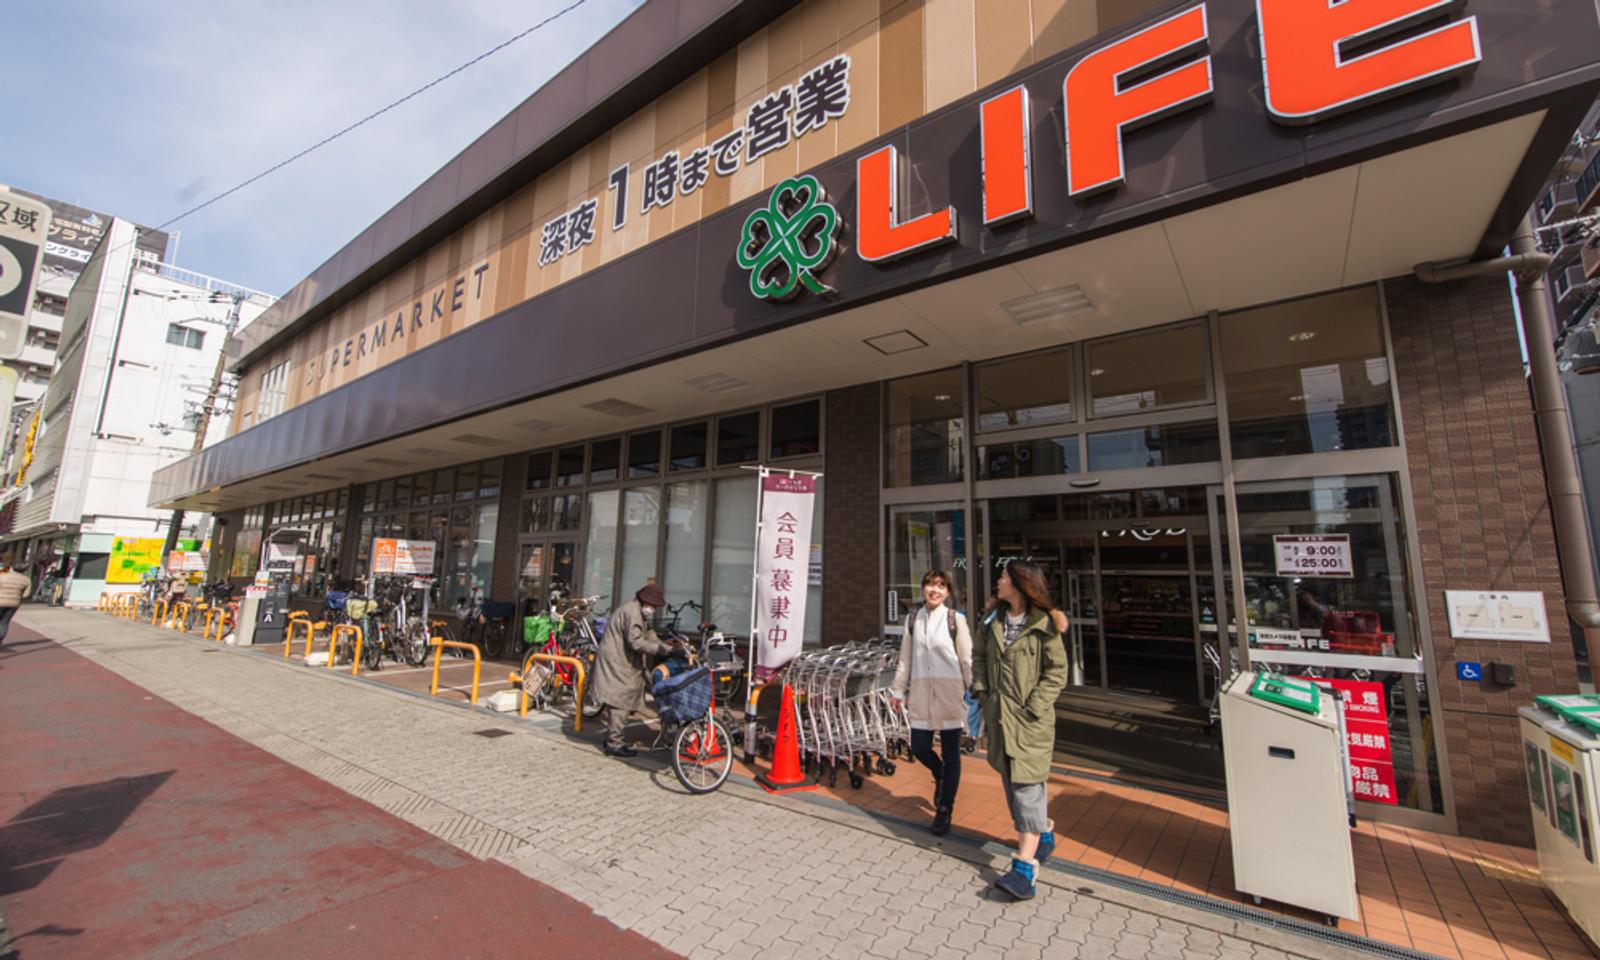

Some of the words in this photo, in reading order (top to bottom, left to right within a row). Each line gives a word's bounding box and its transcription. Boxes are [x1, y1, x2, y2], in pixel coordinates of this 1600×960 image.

[537, 53, 851, 268] 深夜1時まで営業
[857, 0, 1482, 263] LIFE
[305, 262, 489, 386] SUPERMARKET
[1301, 558, 1337, 568] 25:00
[1306, 545, 1336, 556] 9:00
